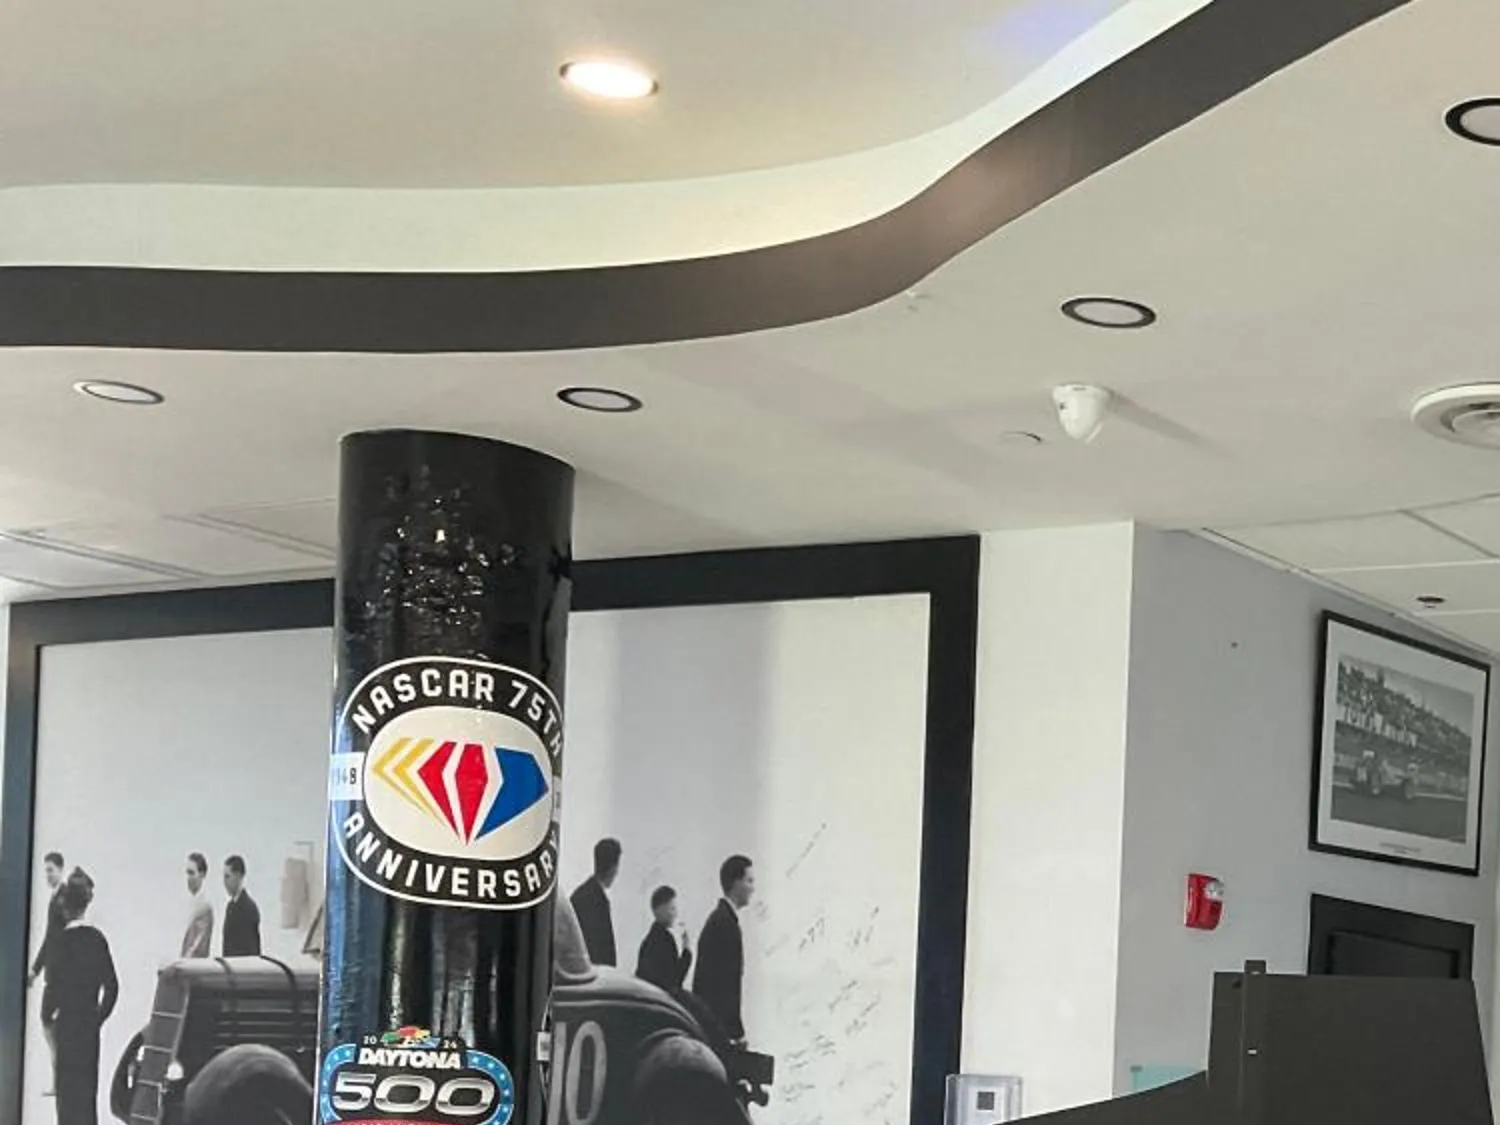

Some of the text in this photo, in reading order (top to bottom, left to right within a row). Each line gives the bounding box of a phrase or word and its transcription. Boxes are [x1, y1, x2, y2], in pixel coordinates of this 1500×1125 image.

[352, 668, 494, 734] NASCAR
[358, 1048, 461, 1069] DAYTONA
[332, 1072, 495, 1115] 500
